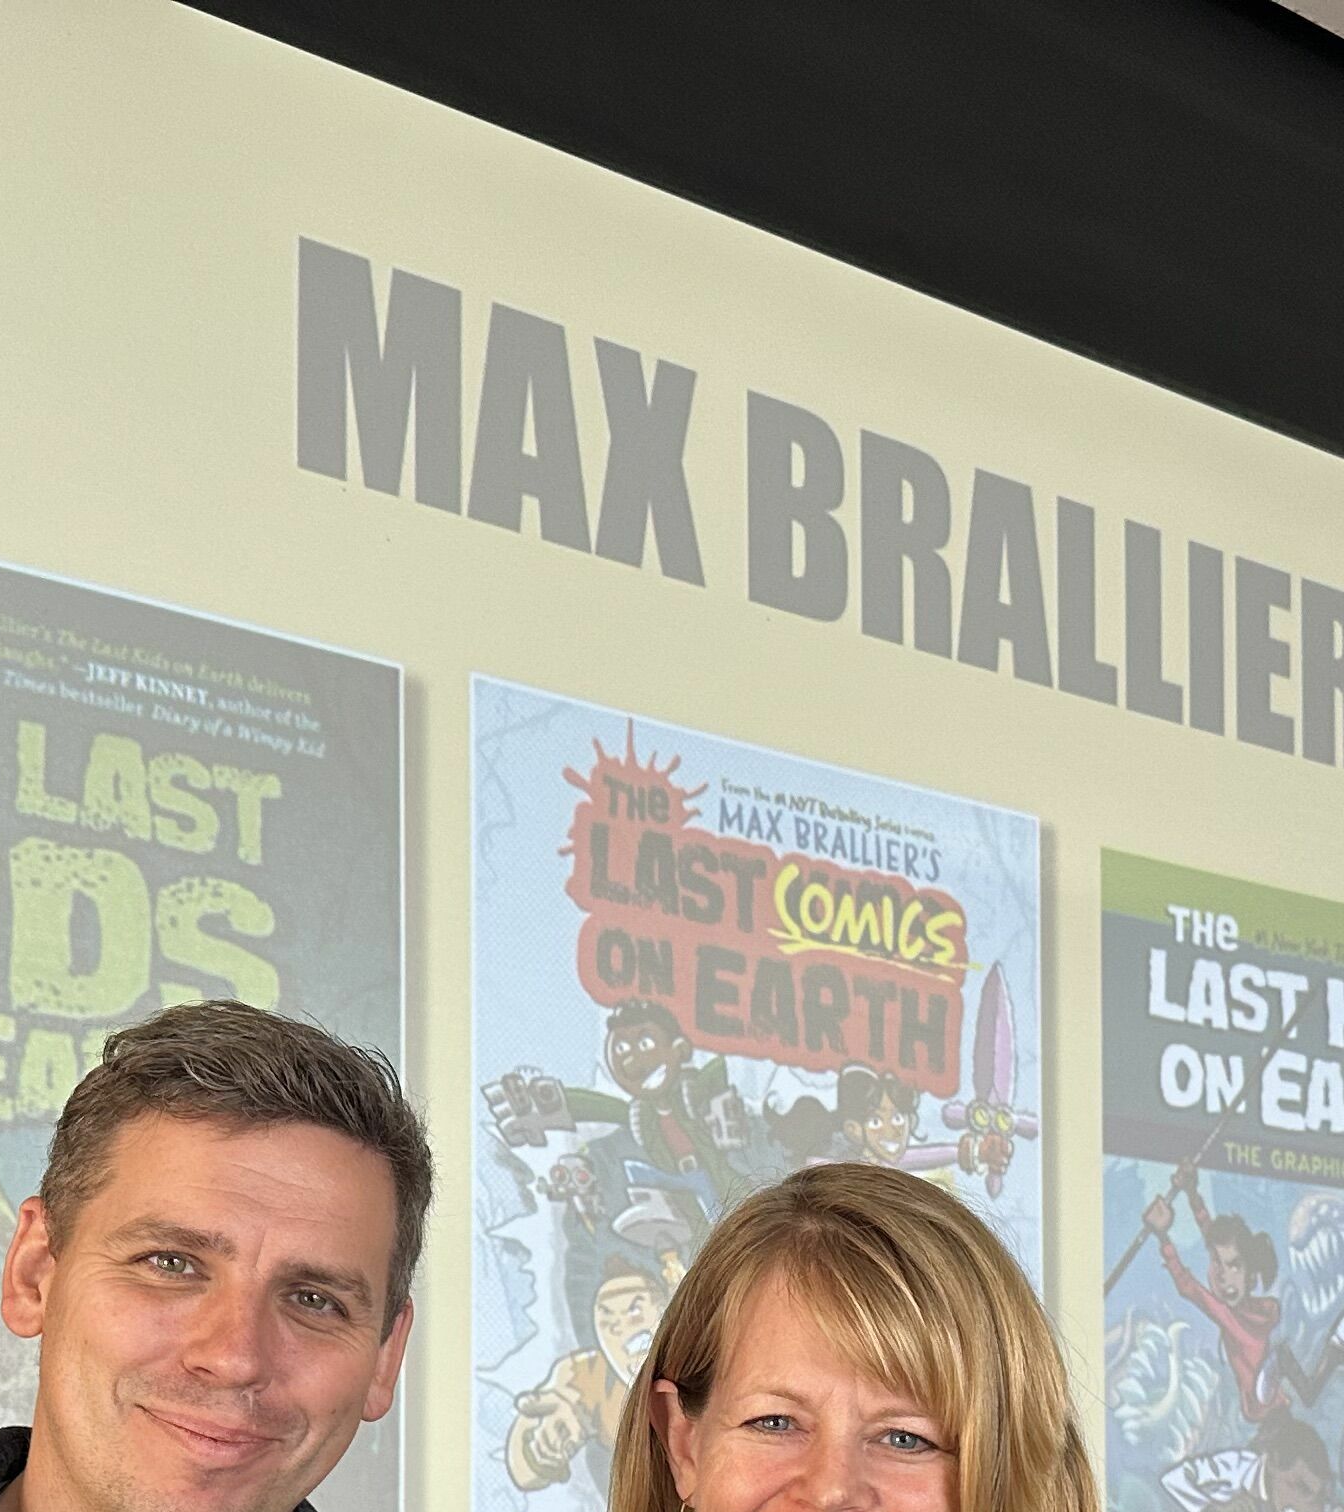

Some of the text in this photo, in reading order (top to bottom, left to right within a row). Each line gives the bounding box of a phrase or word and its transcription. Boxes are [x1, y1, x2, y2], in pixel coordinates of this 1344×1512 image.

[297, 235, 706, 588] MAX
[3, 667, 56, 696] Times
[58, 680, 144, 719] bestseller
[151, 702, 201, 735] Diary
[237, 721, 294, 756] Wimpy
[296, 734, 328, 759] Kid
[92, 636, 127, 660] Last
[131, 646, 170, 670] Kids
[172, 661, 194, 677] on
[198, 663, 243, 688] Earth
[246, 674, 312, 705] delivers
[216, 696, 271, 722] author
[273, 708, 295, 726] of
[296, 711, 322, 733] the
[16, 719, 282, 867] LAST
[718, 797, 943, 883] MAX BRALLIER'S
[589, 822, 964, 965] LAST COMICS
[595, 927, 949, 1073] ON EARTH
[1149, 948, 1310, 1039] LAST
[1160, 1043, 1246, 1113] ON
[1224, 1141, 1262, 1168] THE
